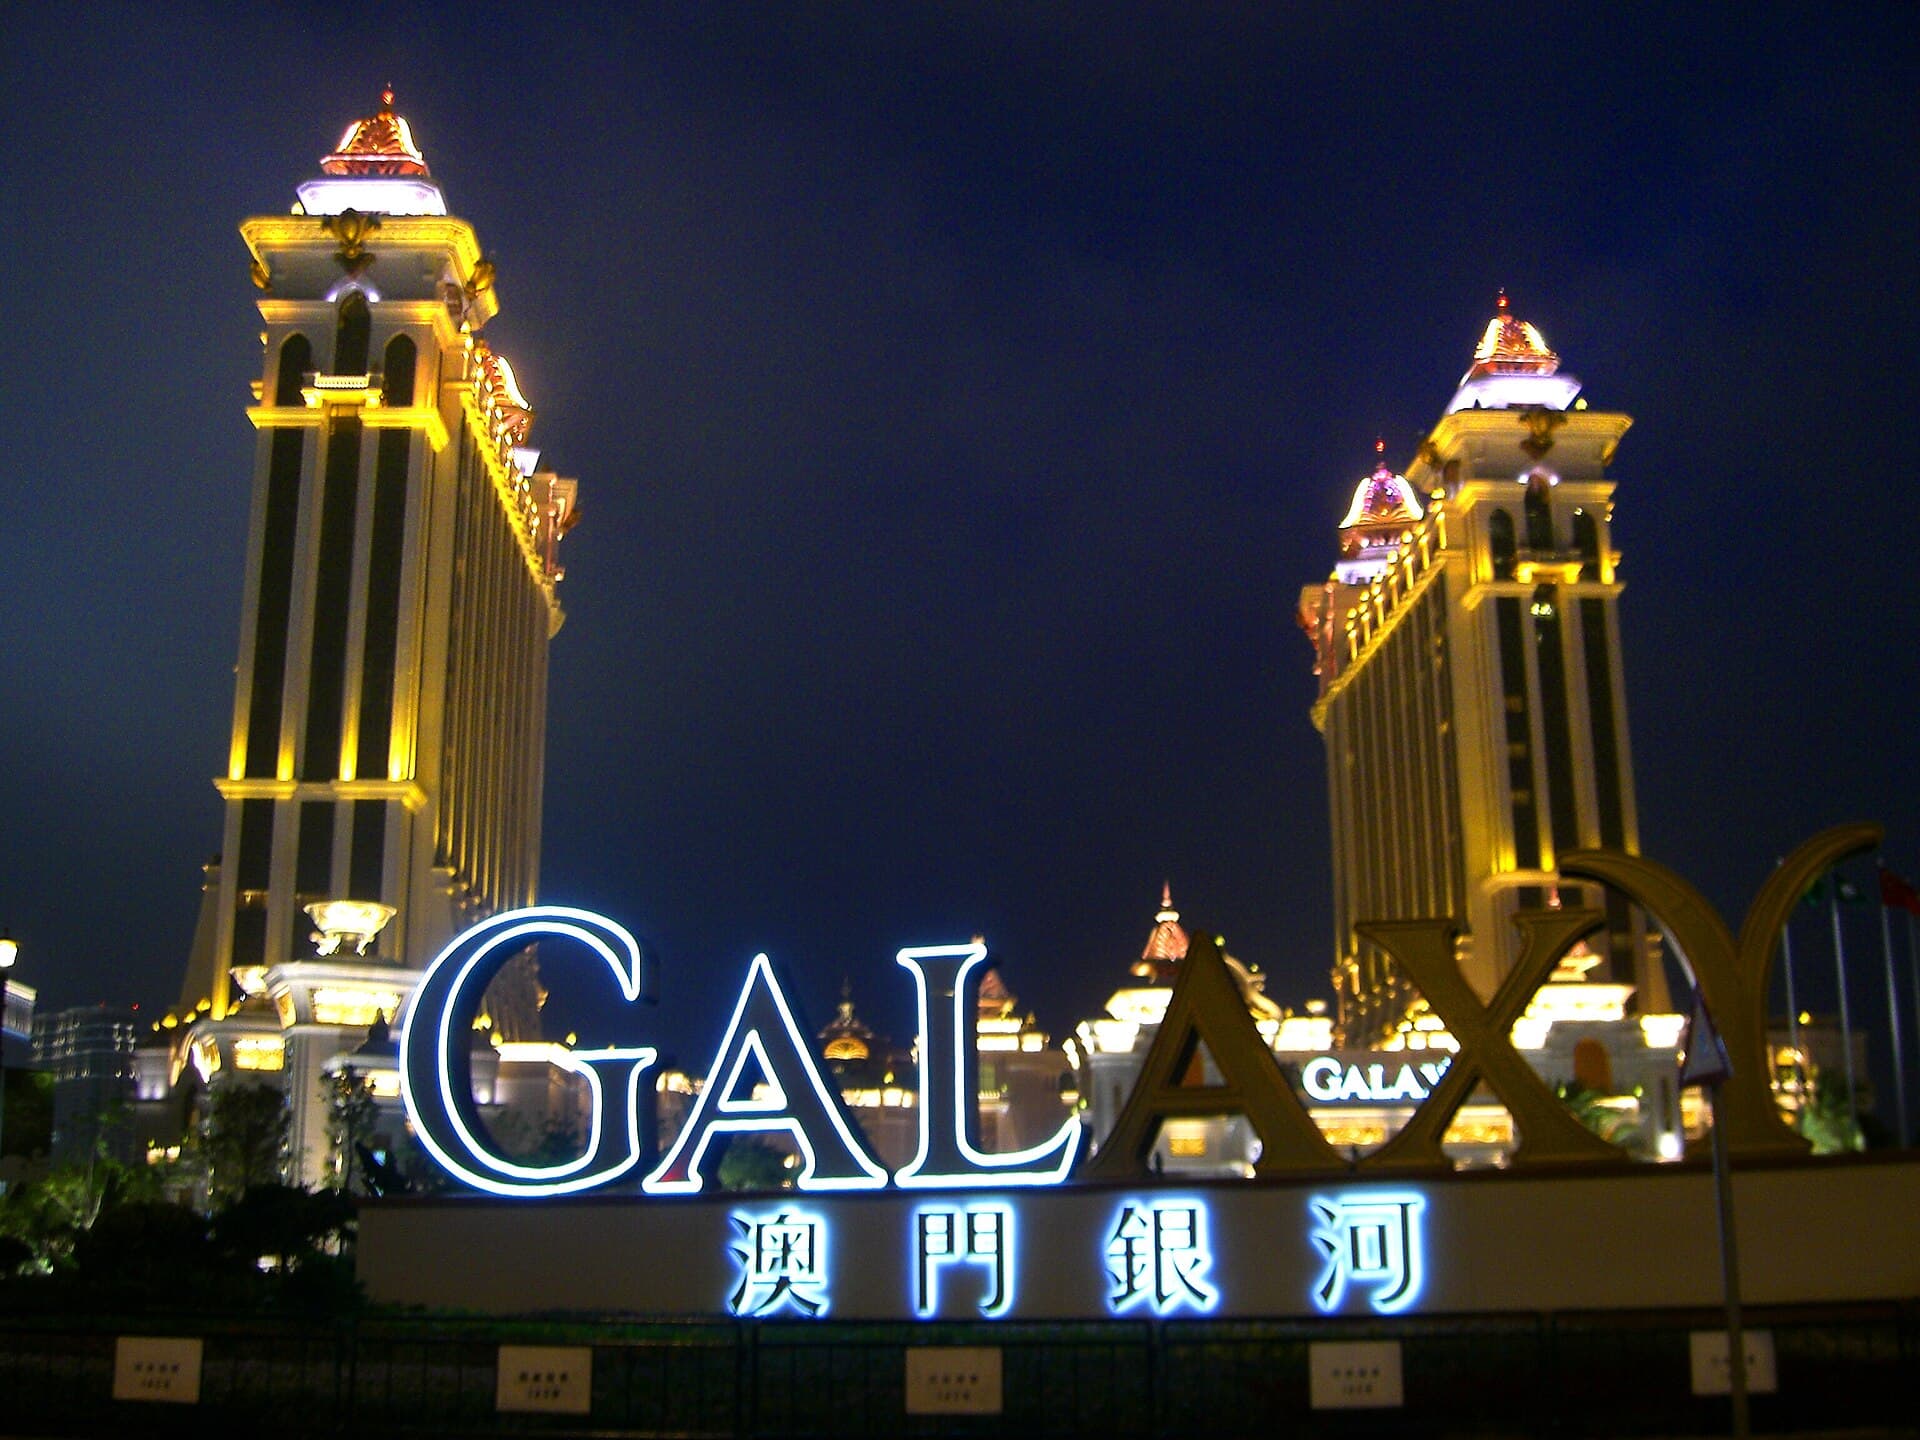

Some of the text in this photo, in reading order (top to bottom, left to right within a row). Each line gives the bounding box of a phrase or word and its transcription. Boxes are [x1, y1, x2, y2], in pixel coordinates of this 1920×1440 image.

[398, 823, 1883, 1200] GALAXY
[727, 1194, 1429, 1320] 澳門銀河
